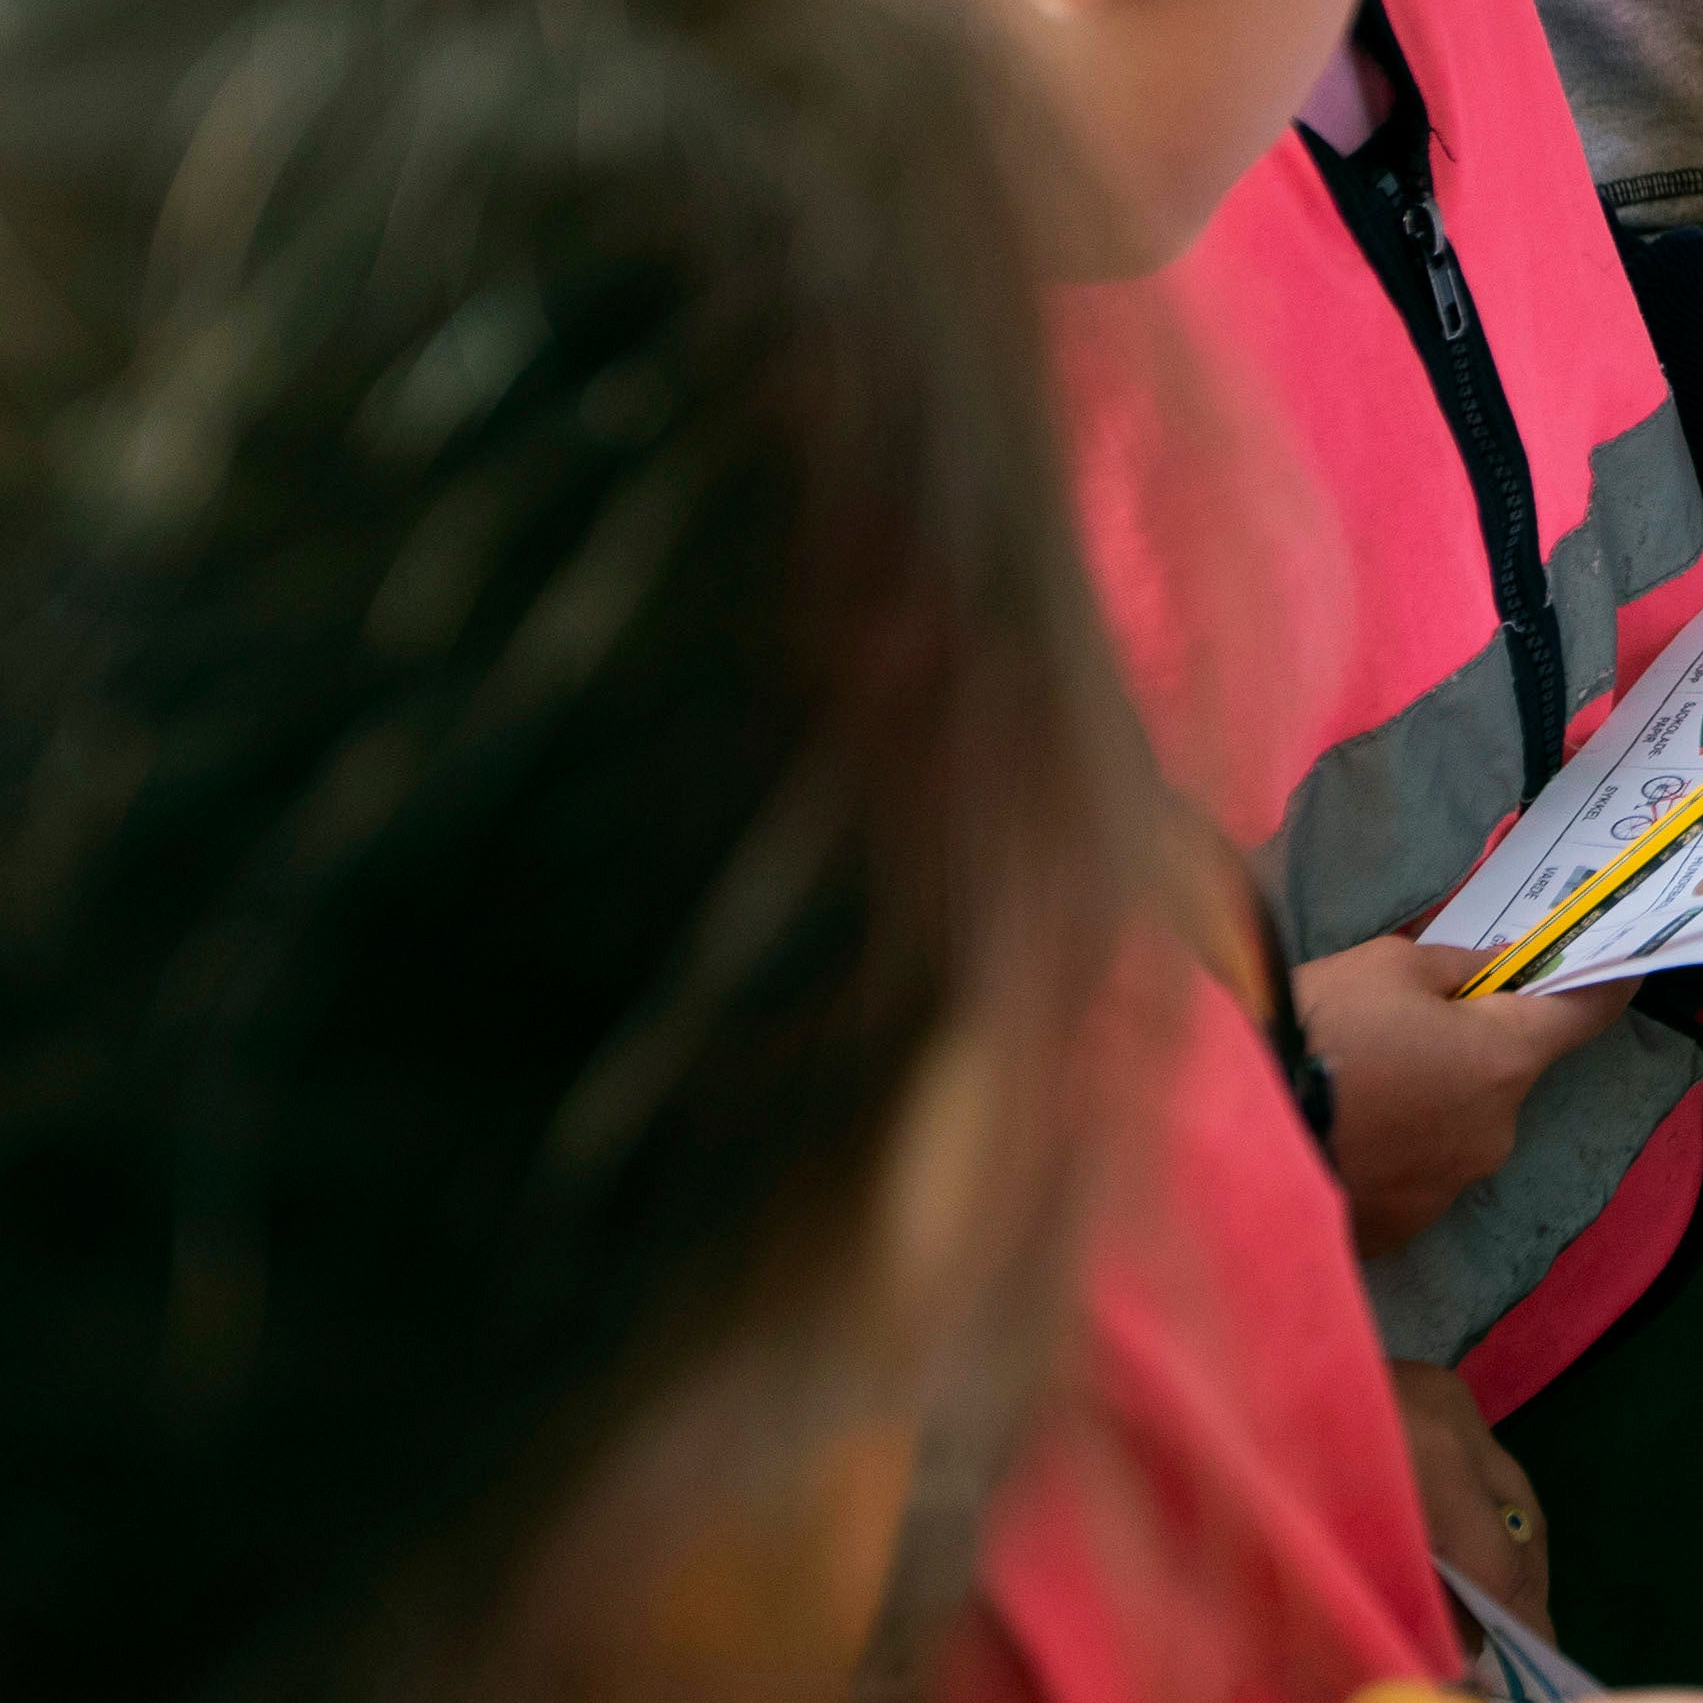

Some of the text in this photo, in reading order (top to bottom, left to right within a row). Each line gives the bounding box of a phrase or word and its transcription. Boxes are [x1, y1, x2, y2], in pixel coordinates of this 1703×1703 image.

[1643, 715, 1677, 742] PAPIR
[1583, 786, 1618, 820] SYKKEL
[1525, 867, 1557, 899] VARDE
